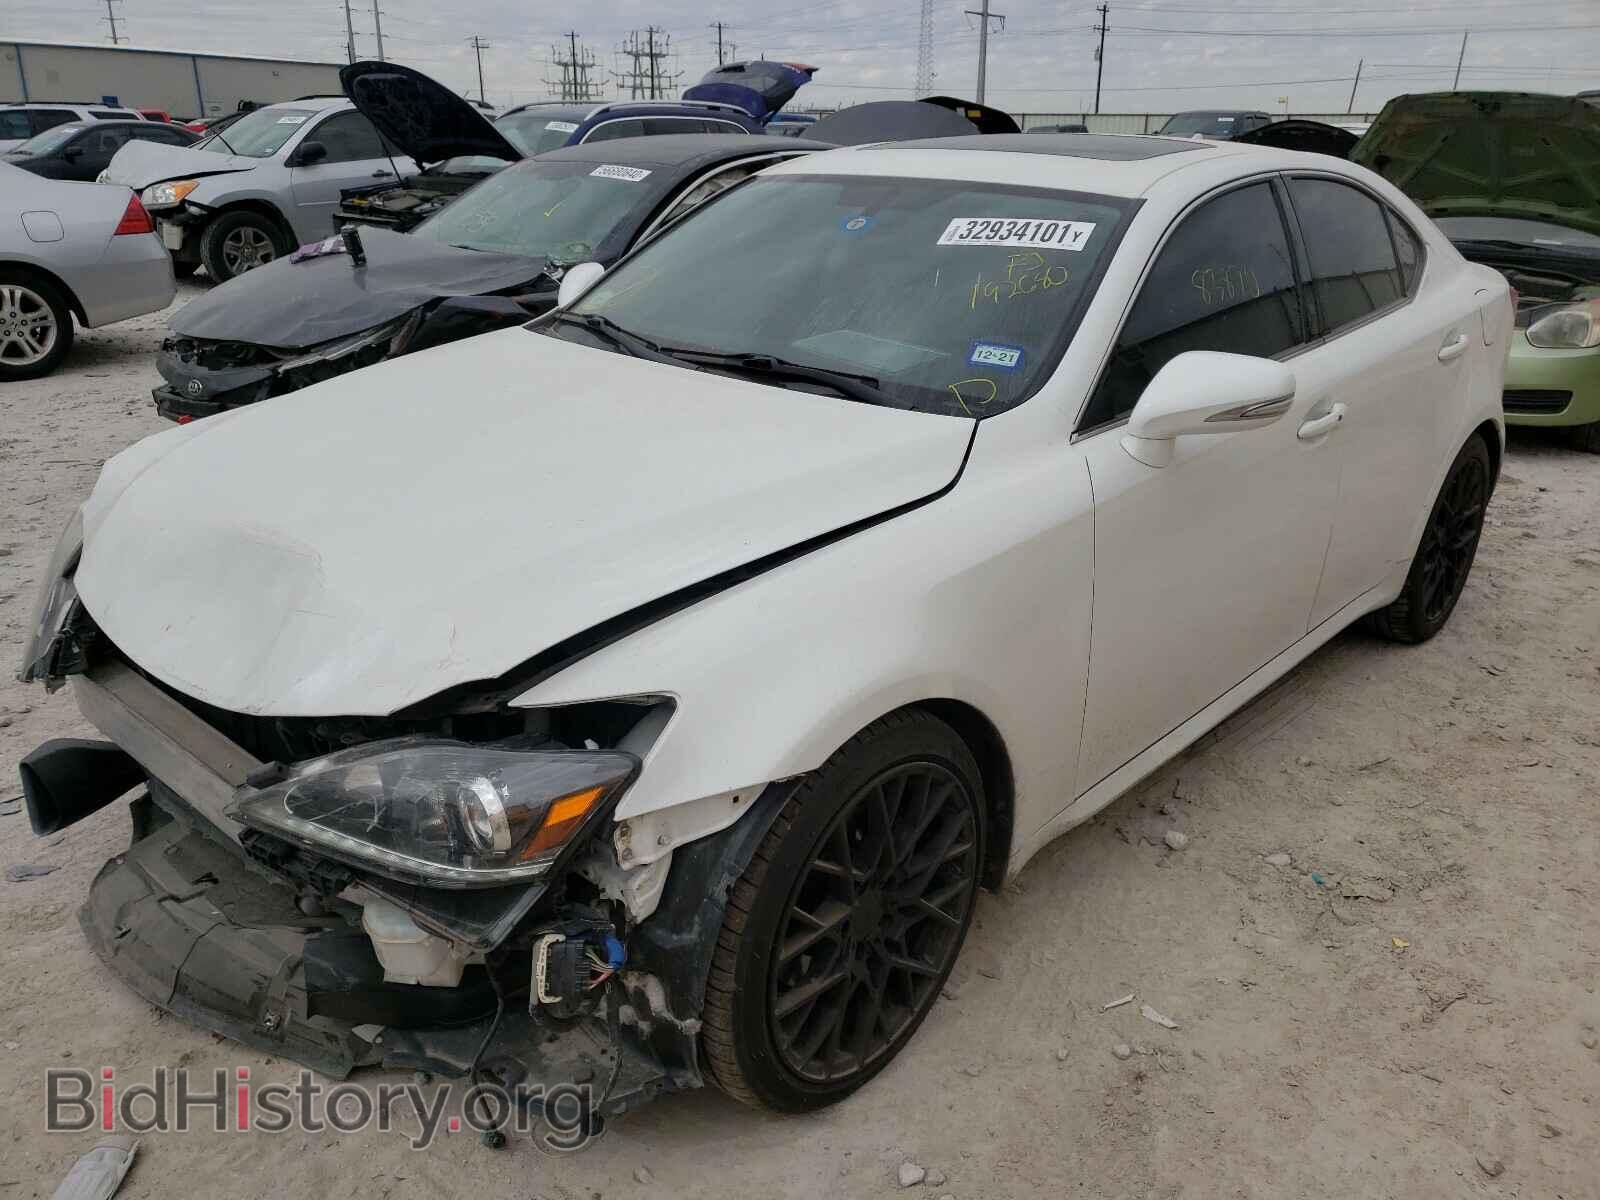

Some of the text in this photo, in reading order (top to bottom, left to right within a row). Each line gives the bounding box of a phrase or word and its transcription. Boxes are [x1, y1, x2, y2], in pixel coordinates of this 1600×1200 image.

[958, 220, 1072, 244] 32934101
[1072, 231, 1083, 243] Y
[976, 350, 1015, 363] 12-21
